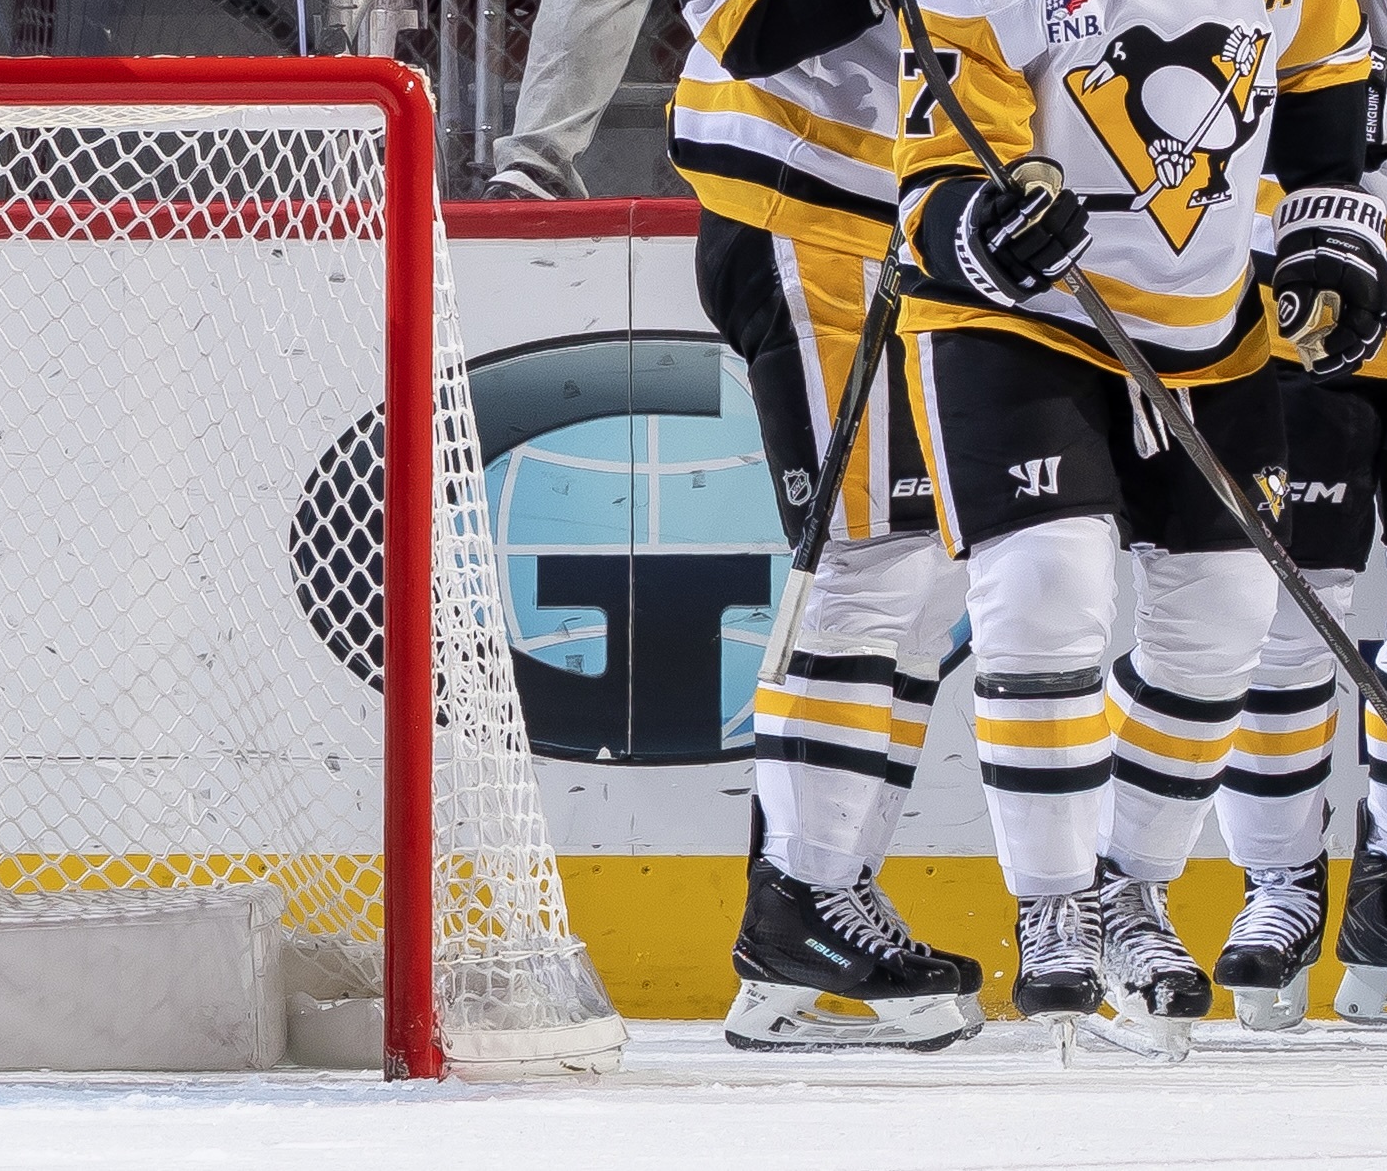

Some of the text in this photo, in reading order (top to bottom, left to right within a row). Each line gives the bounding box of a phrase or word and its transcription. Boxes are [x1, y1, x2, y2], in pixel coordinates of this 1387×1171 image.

[1047, 13, 1103, 44] F.N.B.
[1369, 50, 1387, 71] 87
[1325, 237, 1361, 251] COVERT
[804, 937, 852, 969] BAUER
